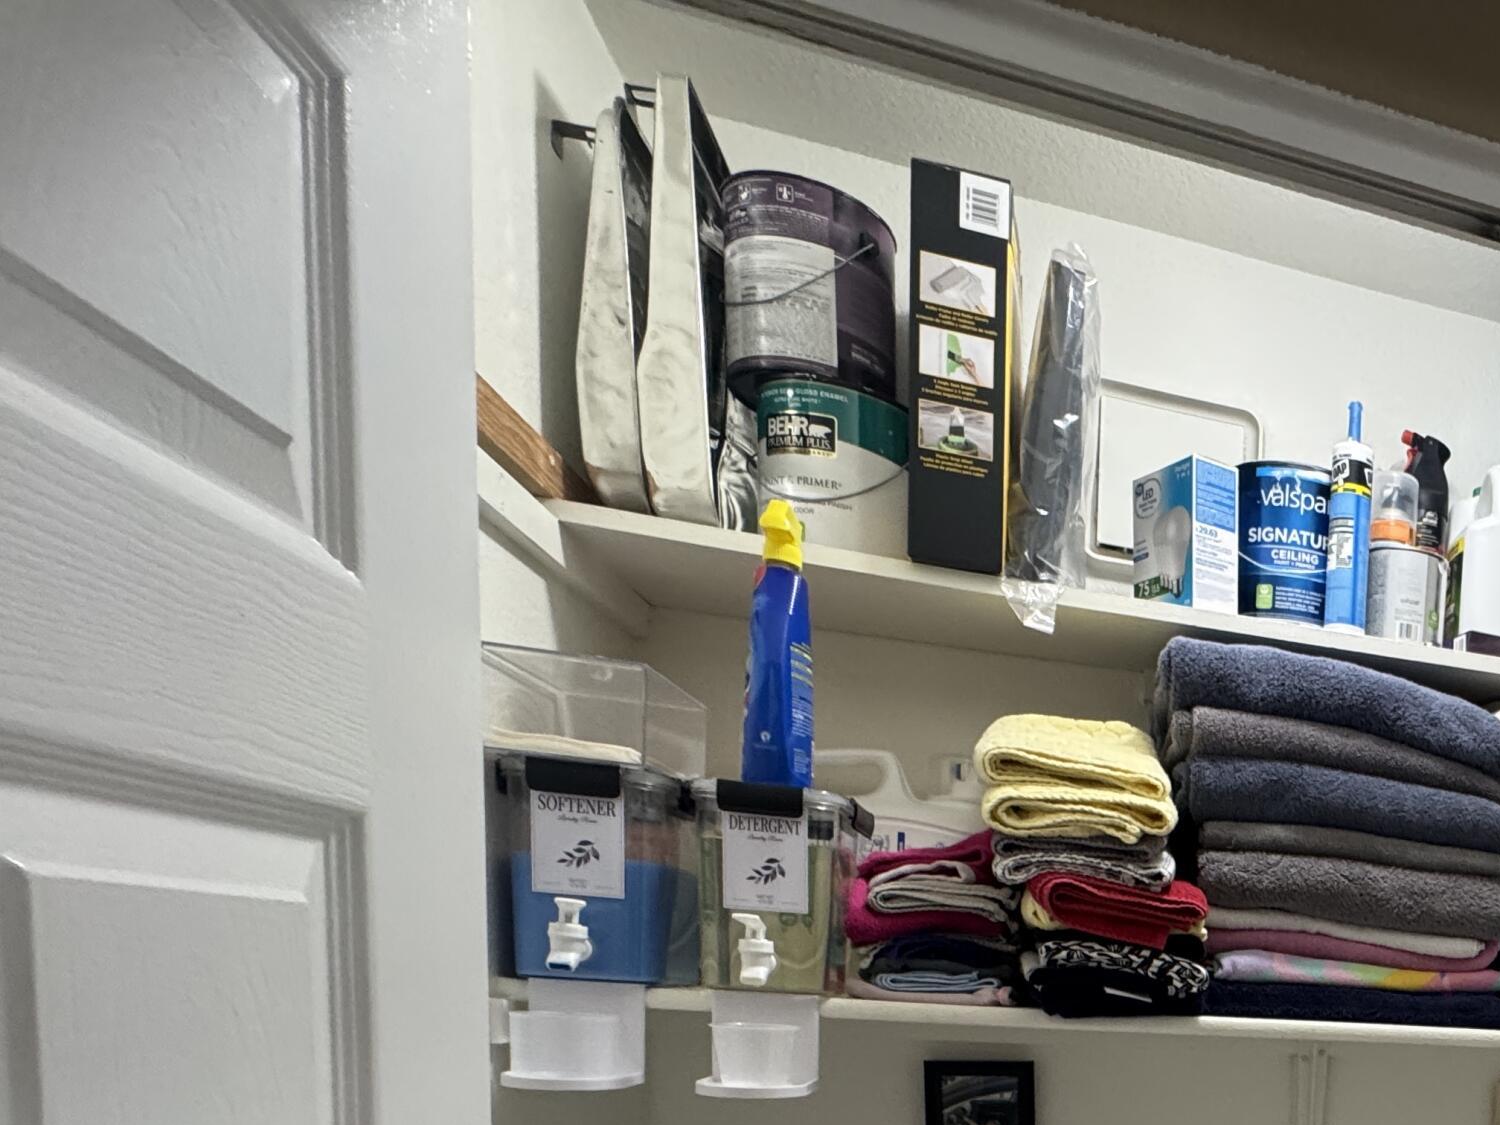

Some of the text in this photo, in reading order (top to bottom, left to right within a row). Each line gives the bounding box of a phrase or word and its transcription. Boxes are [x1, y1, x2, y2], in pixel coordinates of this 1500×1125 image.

[767, 415, 809, 437] BEHR
[767, 435, 803, 448] PREMIUM
[1261, 484, 1329, 516] valspa
[1271, 549, 1319, 565] CEILING
[1138, 581, 1150, 598] 75
[538, 794, 616, 818] SOFTENER
[729, 814, 801, 836] DETERGENT
